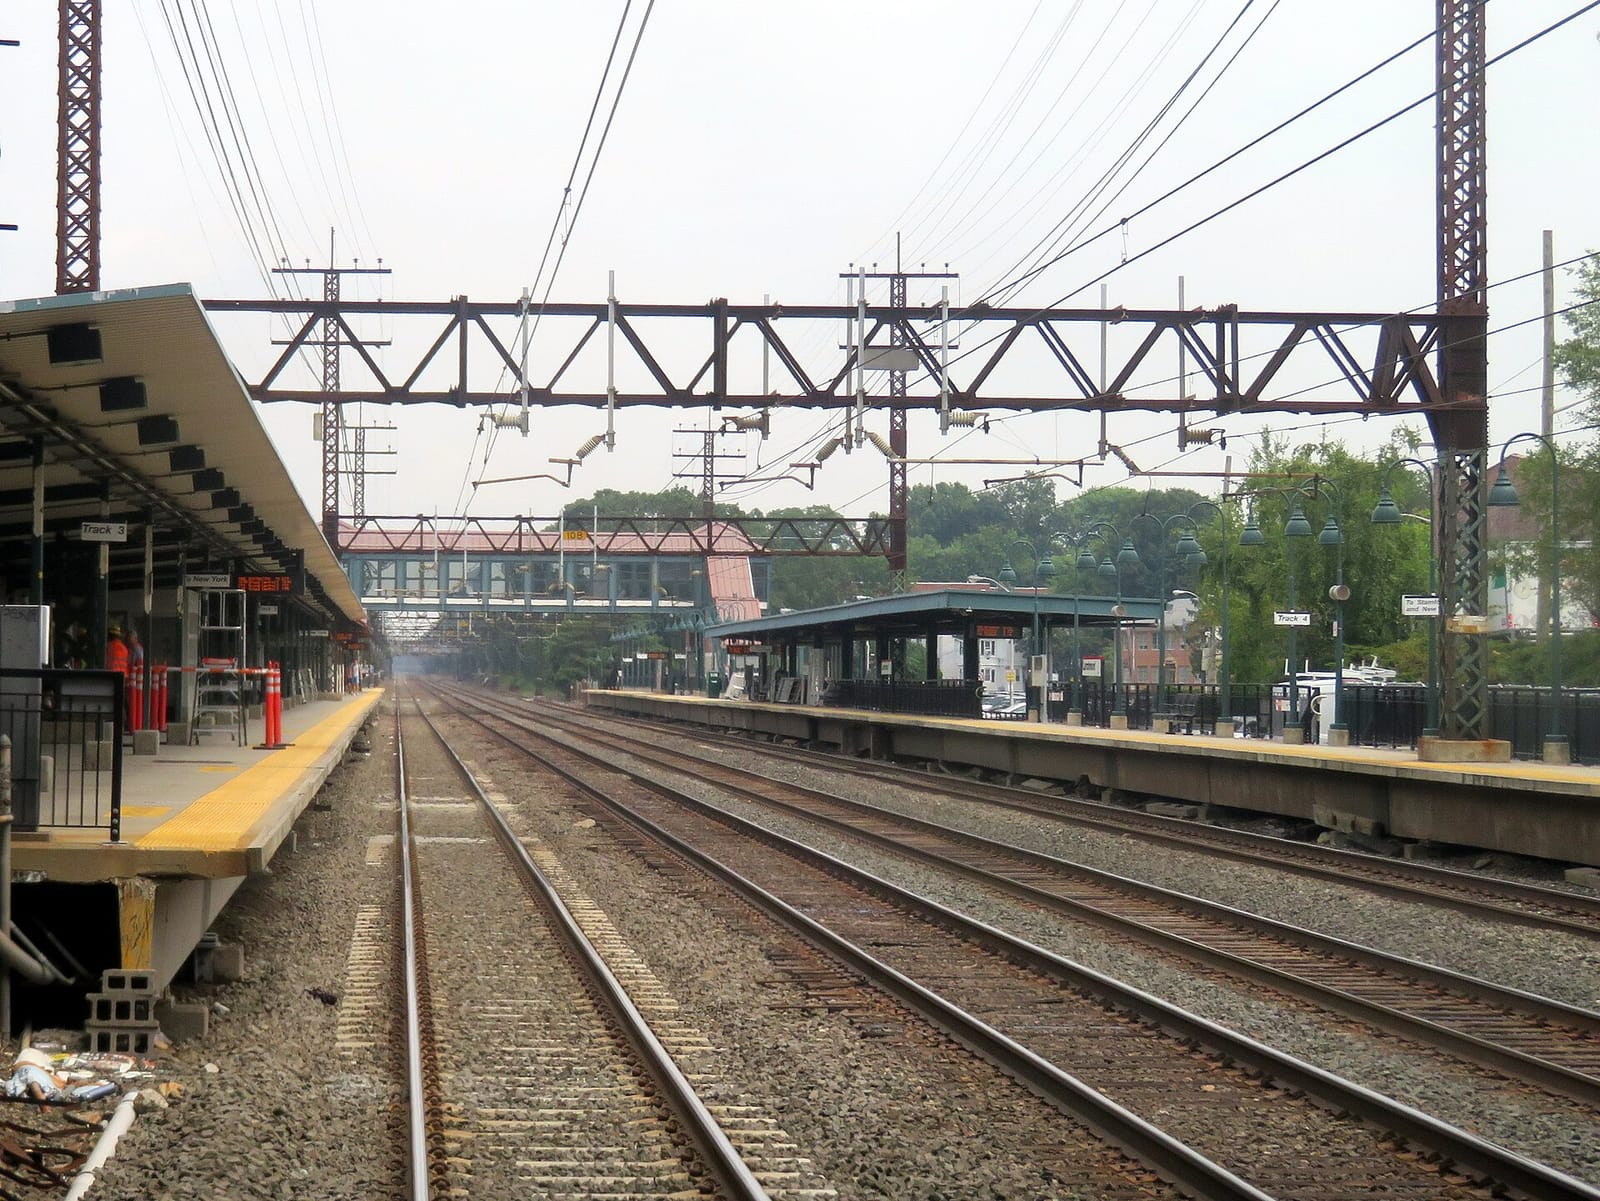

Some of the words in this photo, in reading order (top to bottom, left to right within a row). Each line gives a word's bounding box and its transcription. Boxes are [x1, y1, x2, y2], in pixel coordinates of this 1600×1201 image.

[83, 523, 111, 535] Track
[118, 525, 125, 535] 3
[193, 575, 210, 583] New
[1278, 614, 1299, 622] Track
